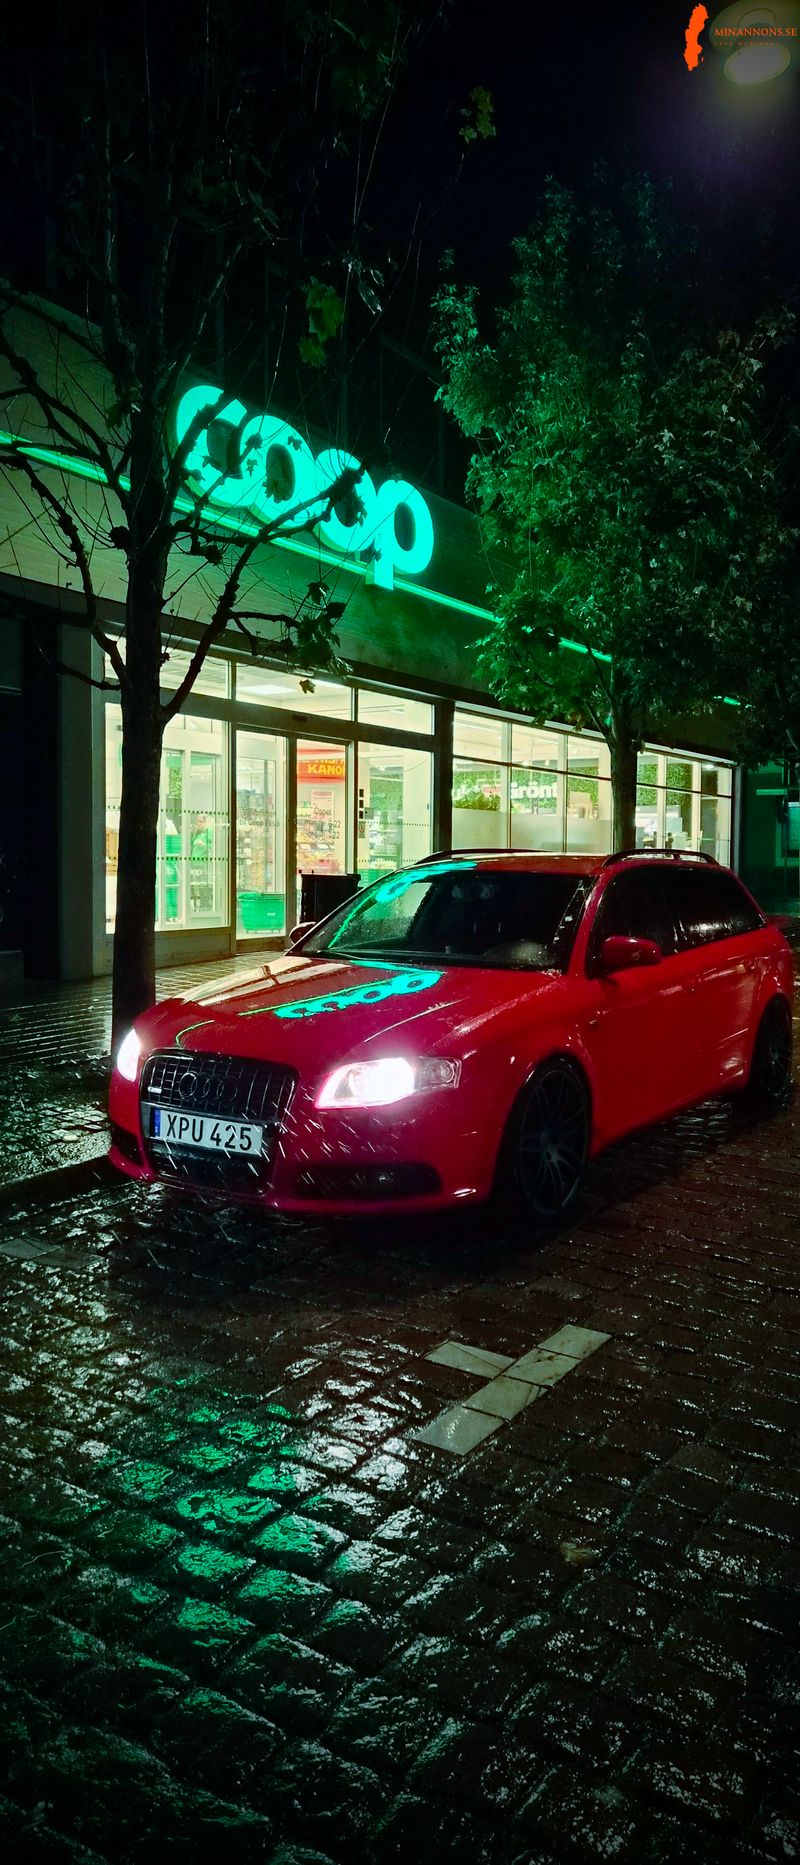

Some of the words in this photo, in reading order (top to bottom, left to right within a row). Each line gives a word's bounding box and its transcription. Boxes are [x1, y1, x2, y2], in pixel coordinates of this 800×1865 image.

[176, 385, 435, 590] coop
[308, 764, 346, 775] KANO
[166, 1114, 204, 1143] XPU
[210, 1123, 252, 1151] 425
